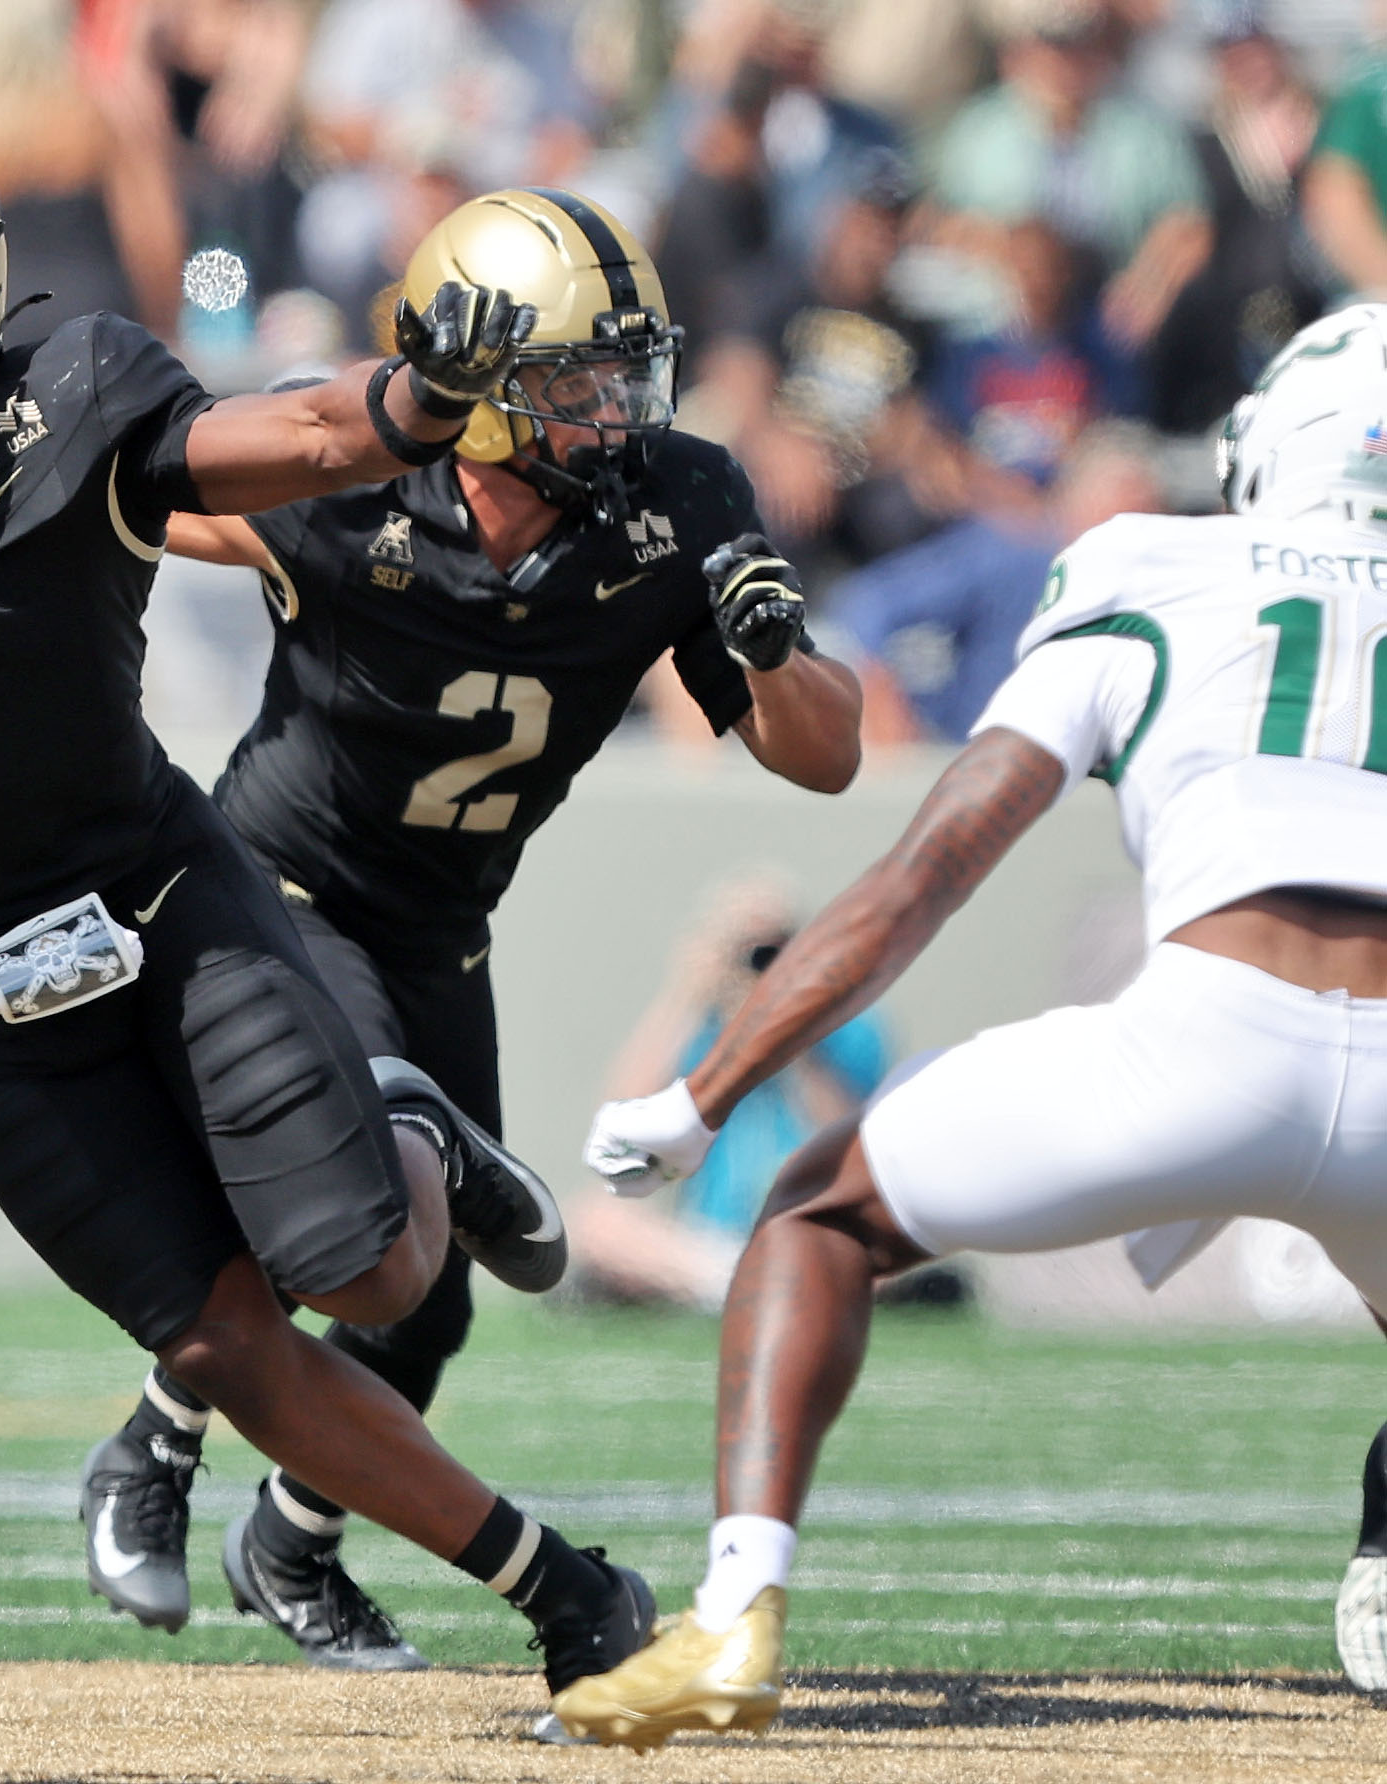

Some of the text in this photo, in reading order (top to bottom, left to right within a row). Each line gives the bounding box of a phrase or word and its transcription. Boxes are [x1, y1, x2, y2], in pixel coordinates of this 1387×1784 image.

[7, 421, 49, 453] USAA
[634, 539, 679, 563] USAA
[370, 564, 416, 591] SELF
[402, 670, 554, 831] 2
